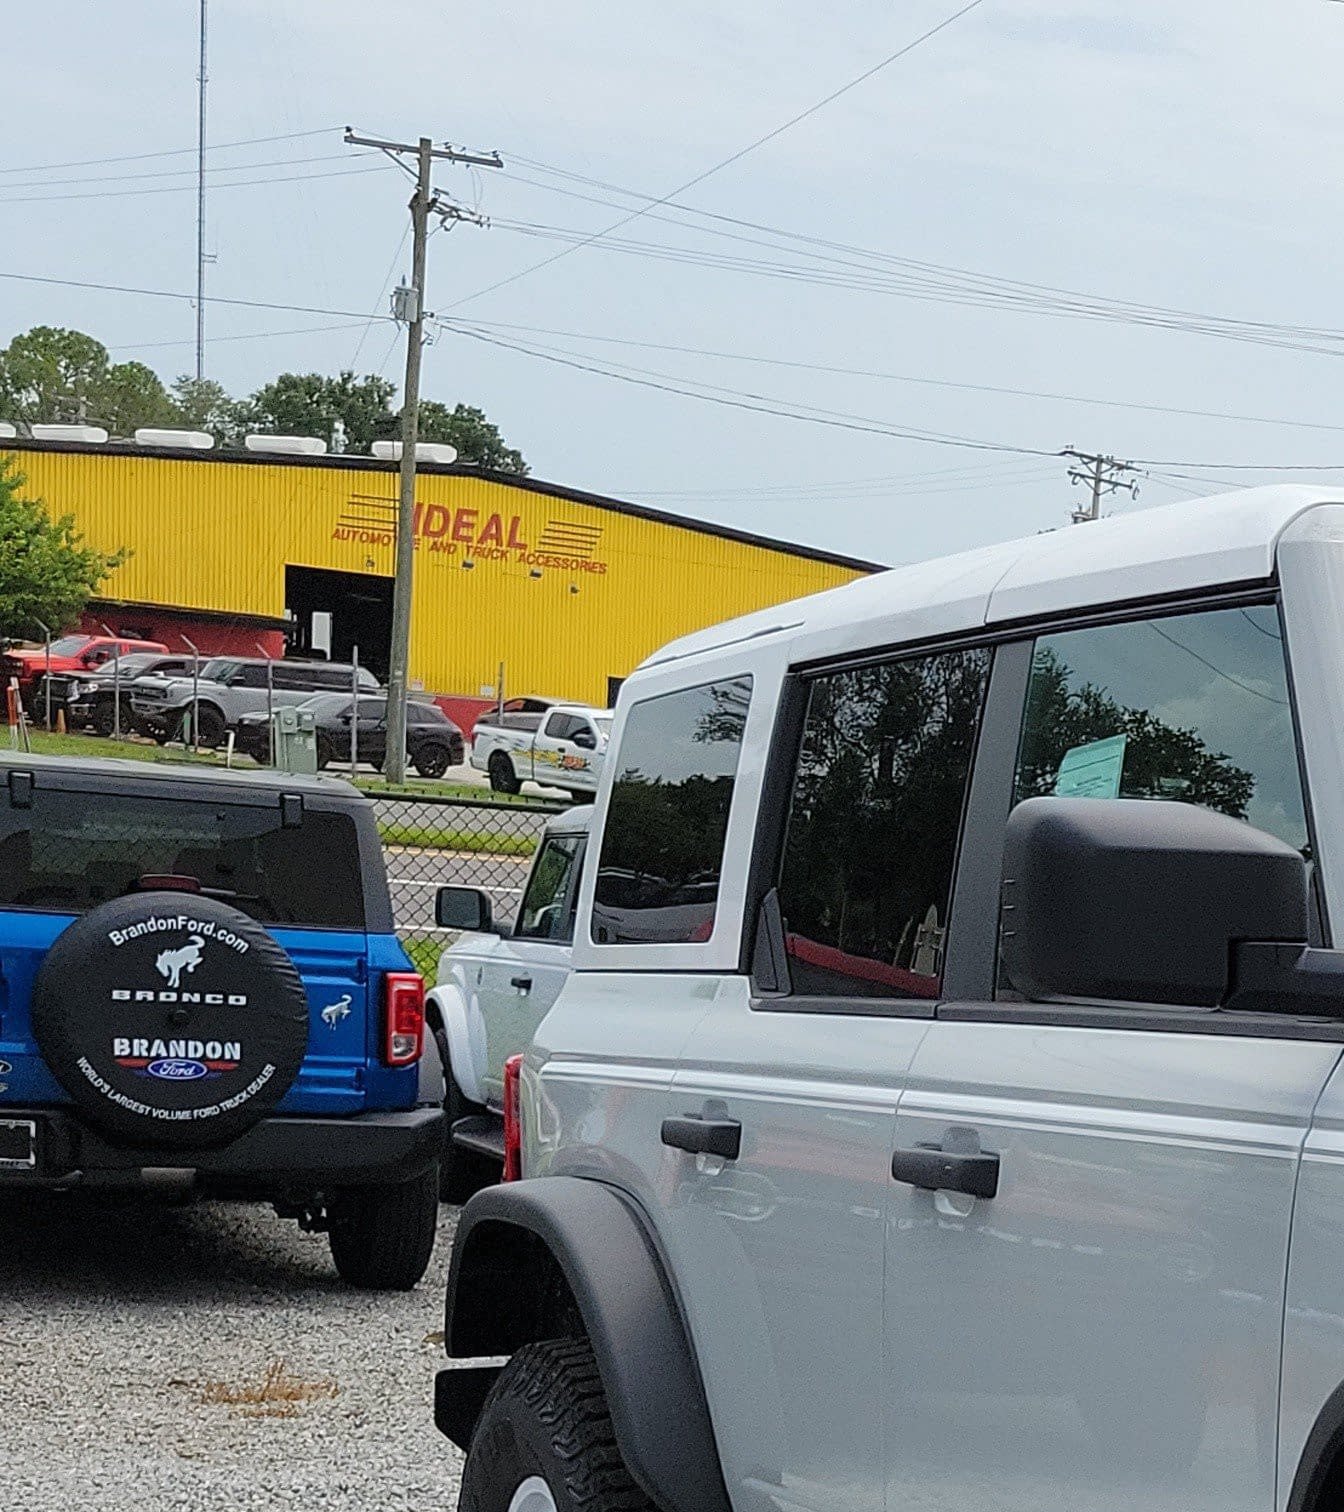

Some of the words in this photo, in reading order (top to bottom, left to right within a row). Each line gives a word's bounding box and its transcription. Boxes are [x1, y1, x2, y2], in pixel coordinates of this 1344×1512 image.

[412, 501, 528, 550] IDEAL
[430, 541, 457, 555] AND
[466, 545, 509, 561] TRUCK
[518, 552, 607, 575] ACCESSORIES
[108, 916, 249, 954] BrandonFord.com
[112, 989, 247, 1005] BRONCO
[113, 1038, 240, 1060] BRANDON
[76, 1056, 109, 1094] WORLD'S
[107, 1089, 151, 1116] LARGEST
[152, 1107, 192, 1121] VOLUME
[193, 1105, 220, 1120] FORD
[219, 1091, 251, 1112] TRUCK
[248, 1063, 276, 1094] DEALER
